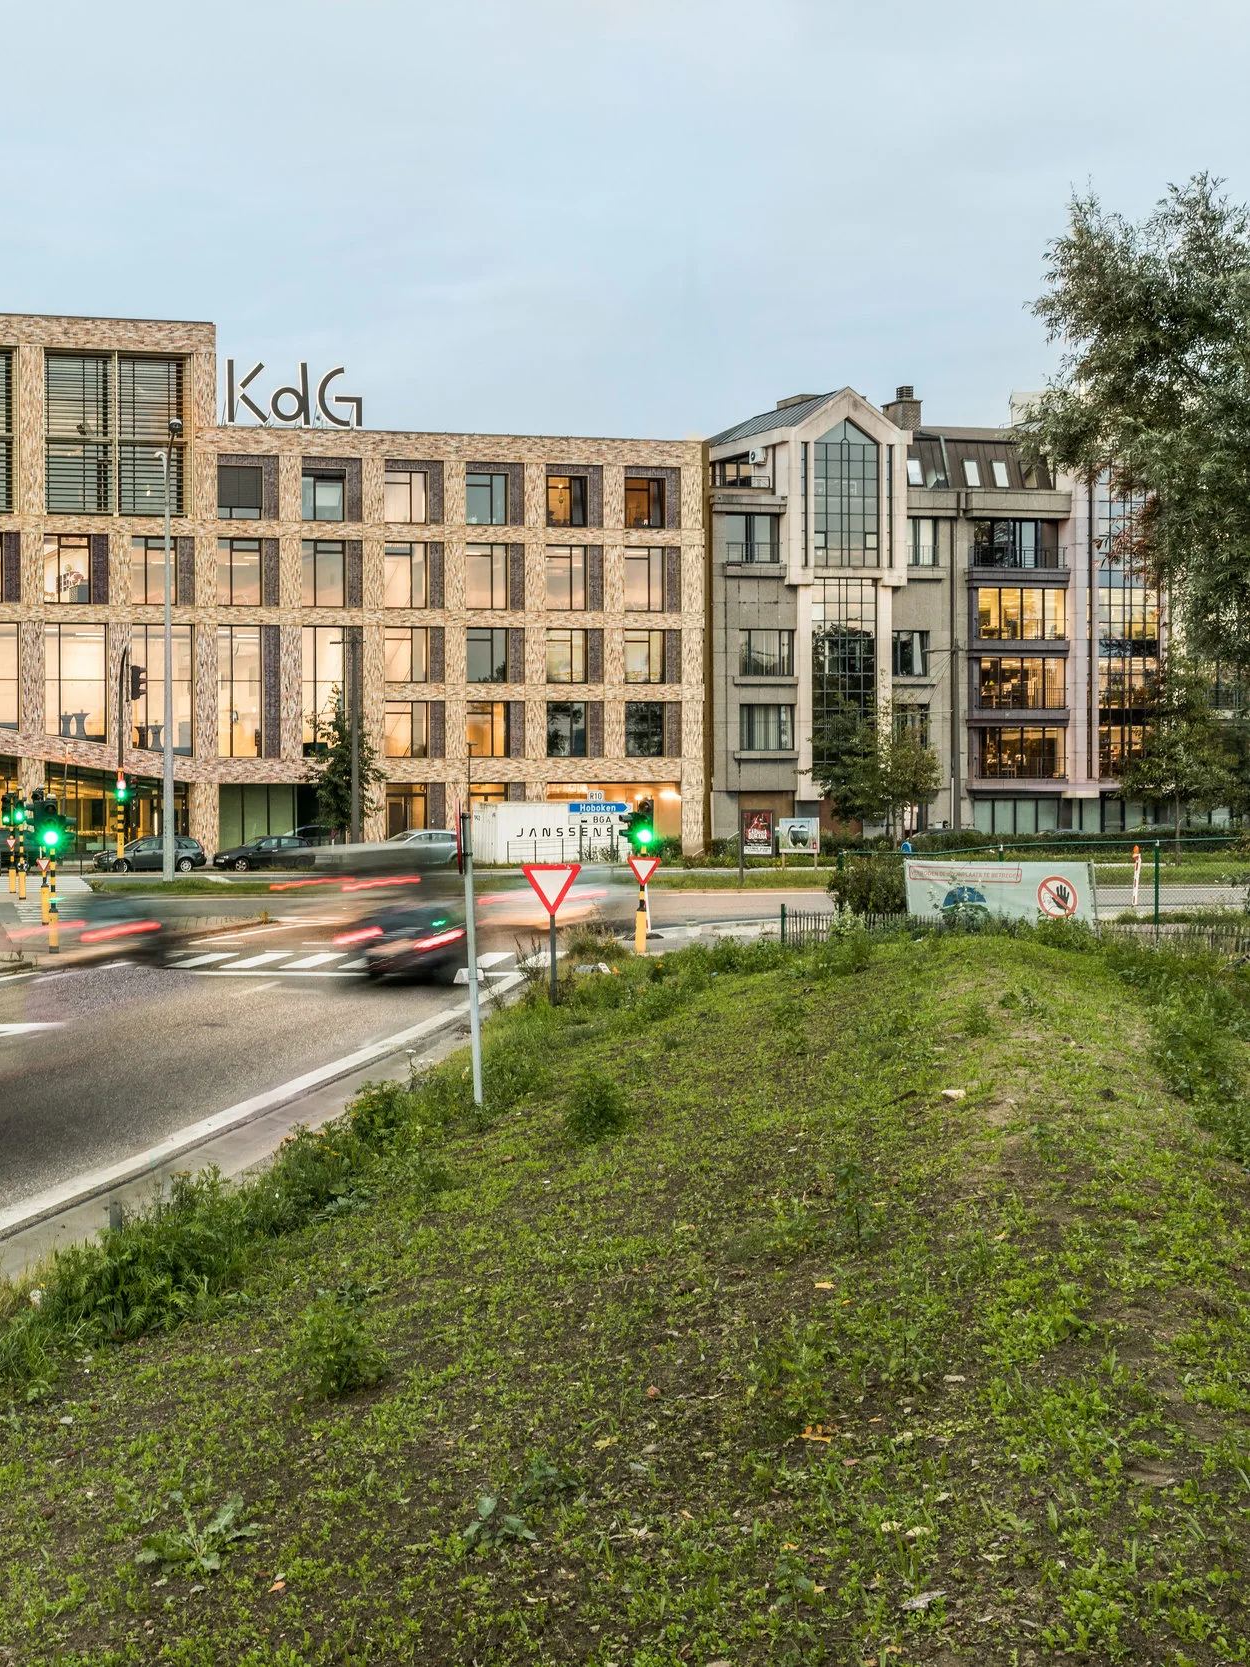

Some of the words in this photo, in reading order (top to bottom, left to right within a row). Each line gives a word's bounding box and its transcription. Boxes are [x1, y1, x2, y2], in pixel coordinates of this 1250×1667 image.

[225, 358, 363, 428] KdG
[589, 792, 603, 800] R10
[579, 804, 616, 812] Hoboken
[516, 827, 613, 838] JANSSENS
